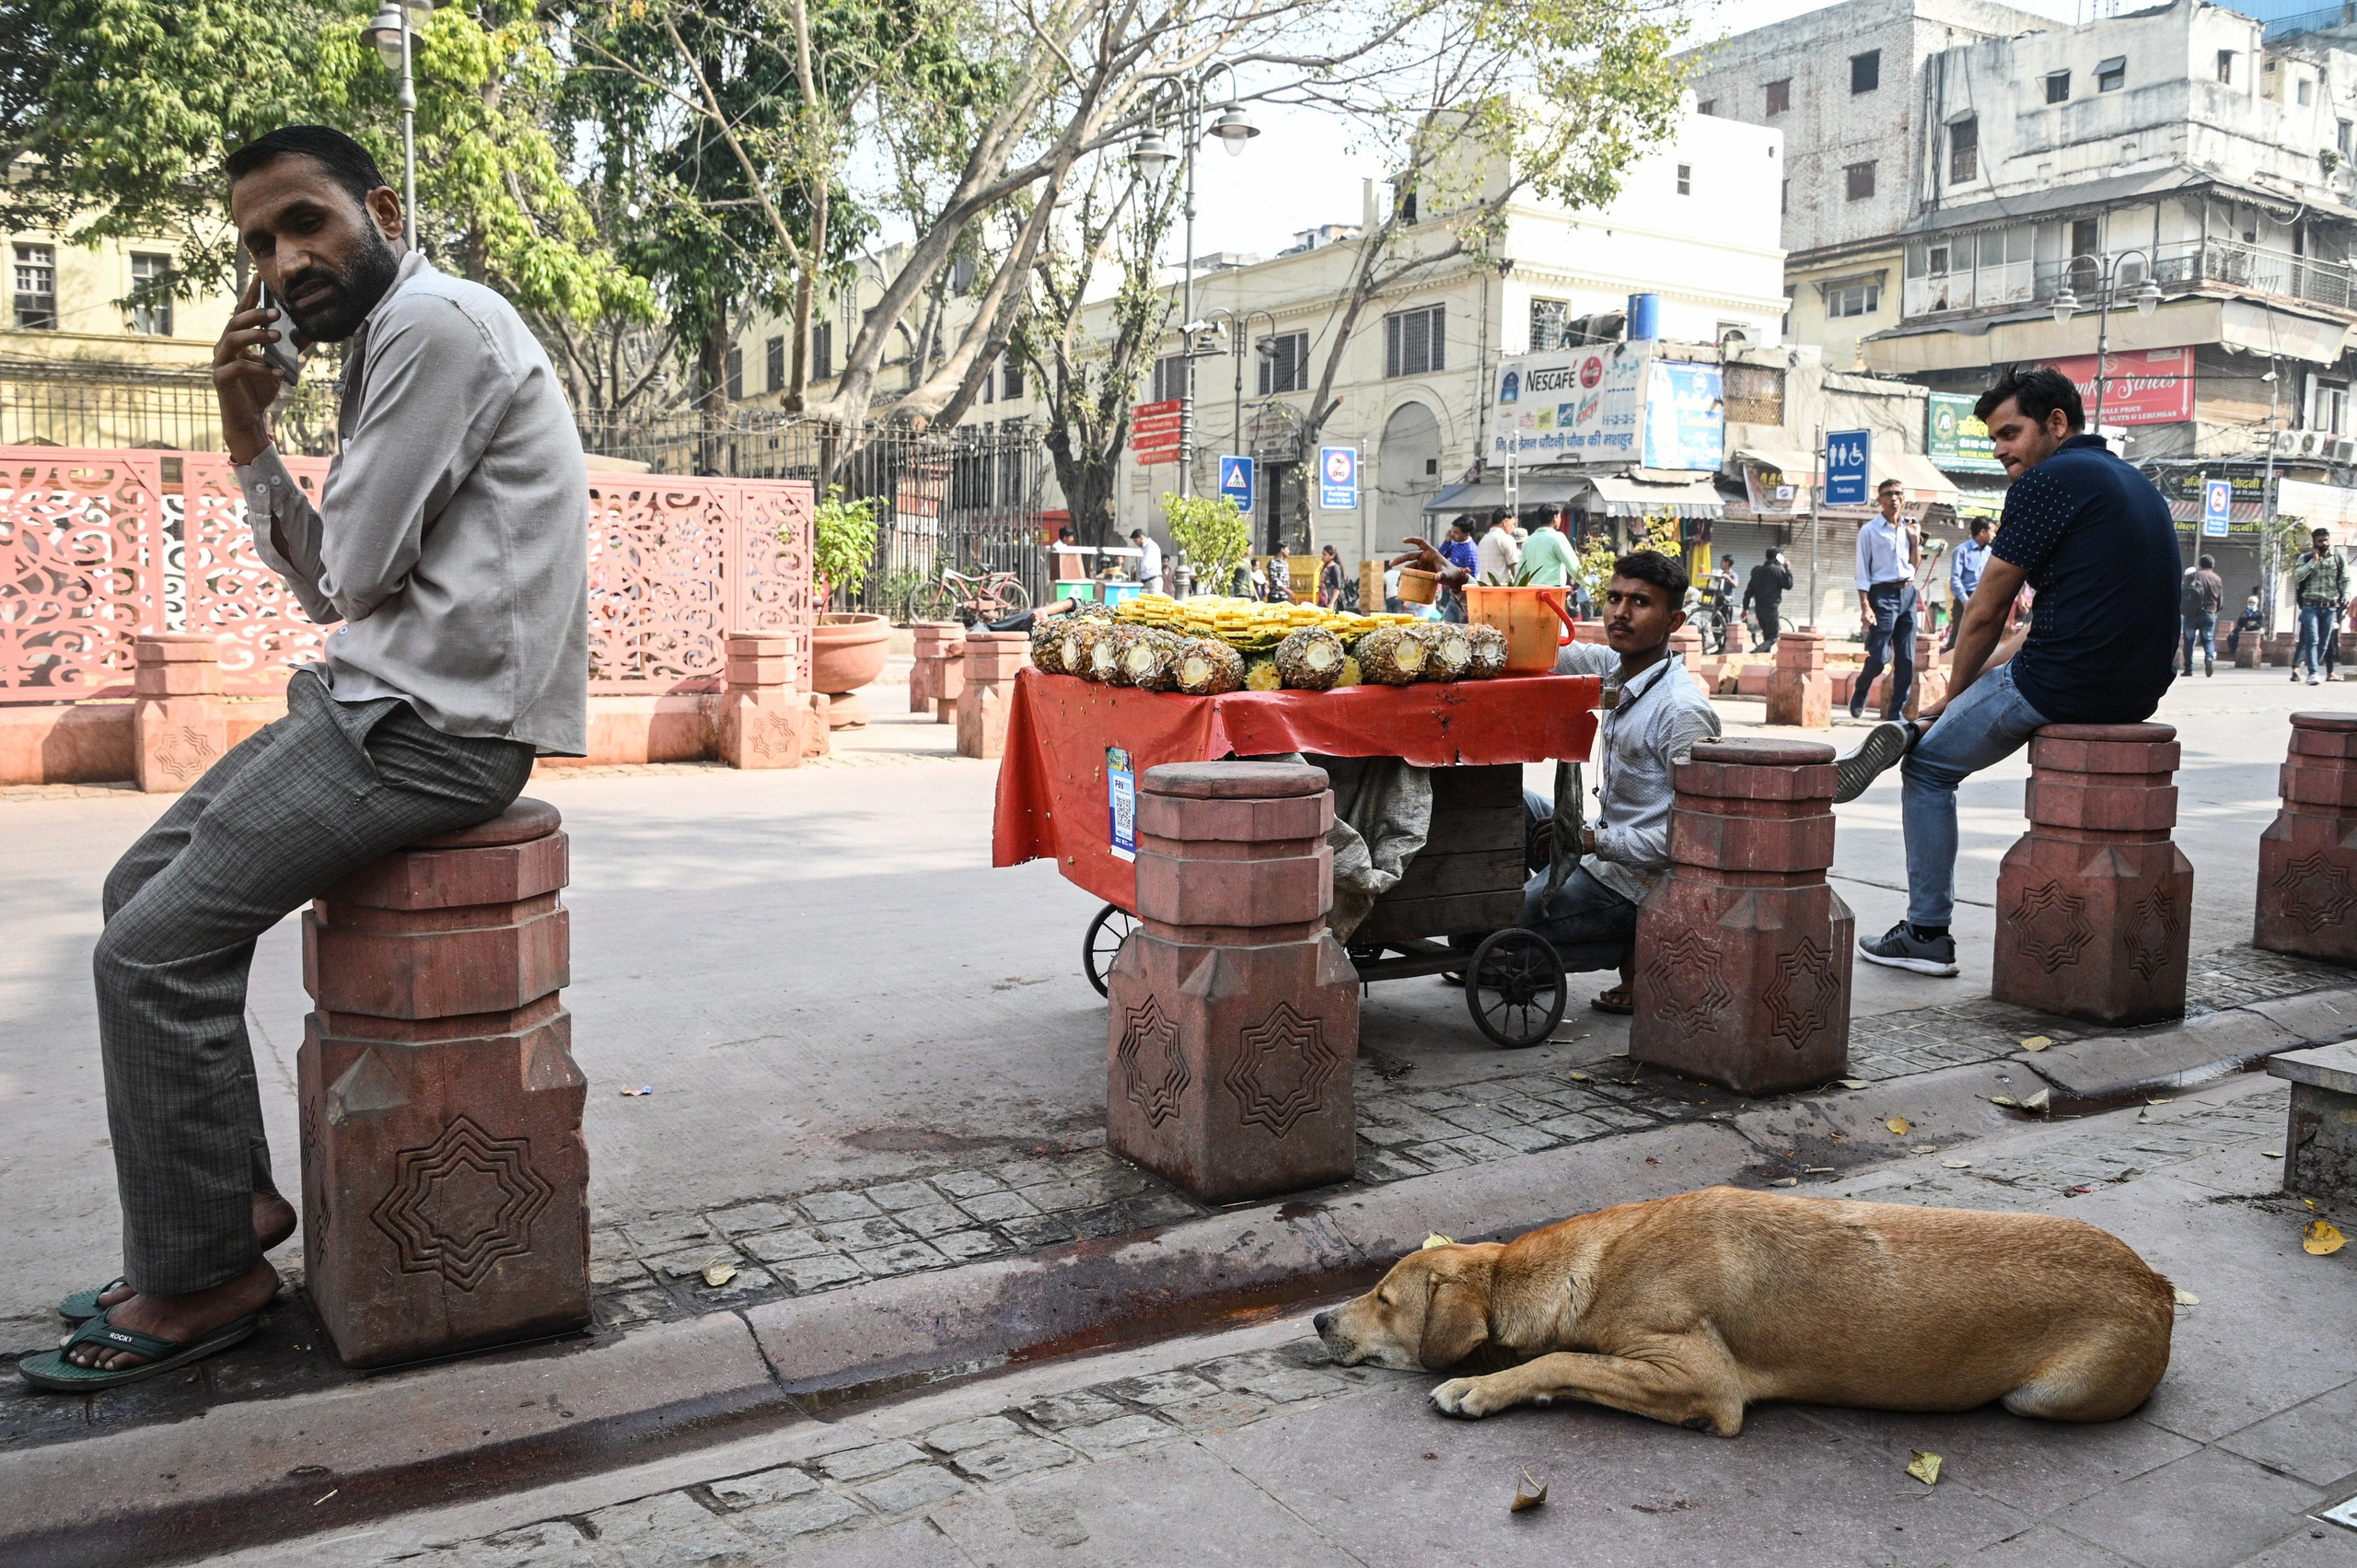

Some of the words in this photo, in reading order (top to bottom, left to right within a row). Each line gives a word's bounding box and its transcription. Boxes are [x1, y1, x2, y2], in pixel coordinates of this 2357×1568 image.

[1525, 359, 1577, 392] NESCAFÉ
[2118, 371, 2177, 399] Sarees
[2138, 411, 2177, 420] LEHENGAS
[1588, 430, 1601, 447] की
[109, 1332, 134, 1342] ROCKY
